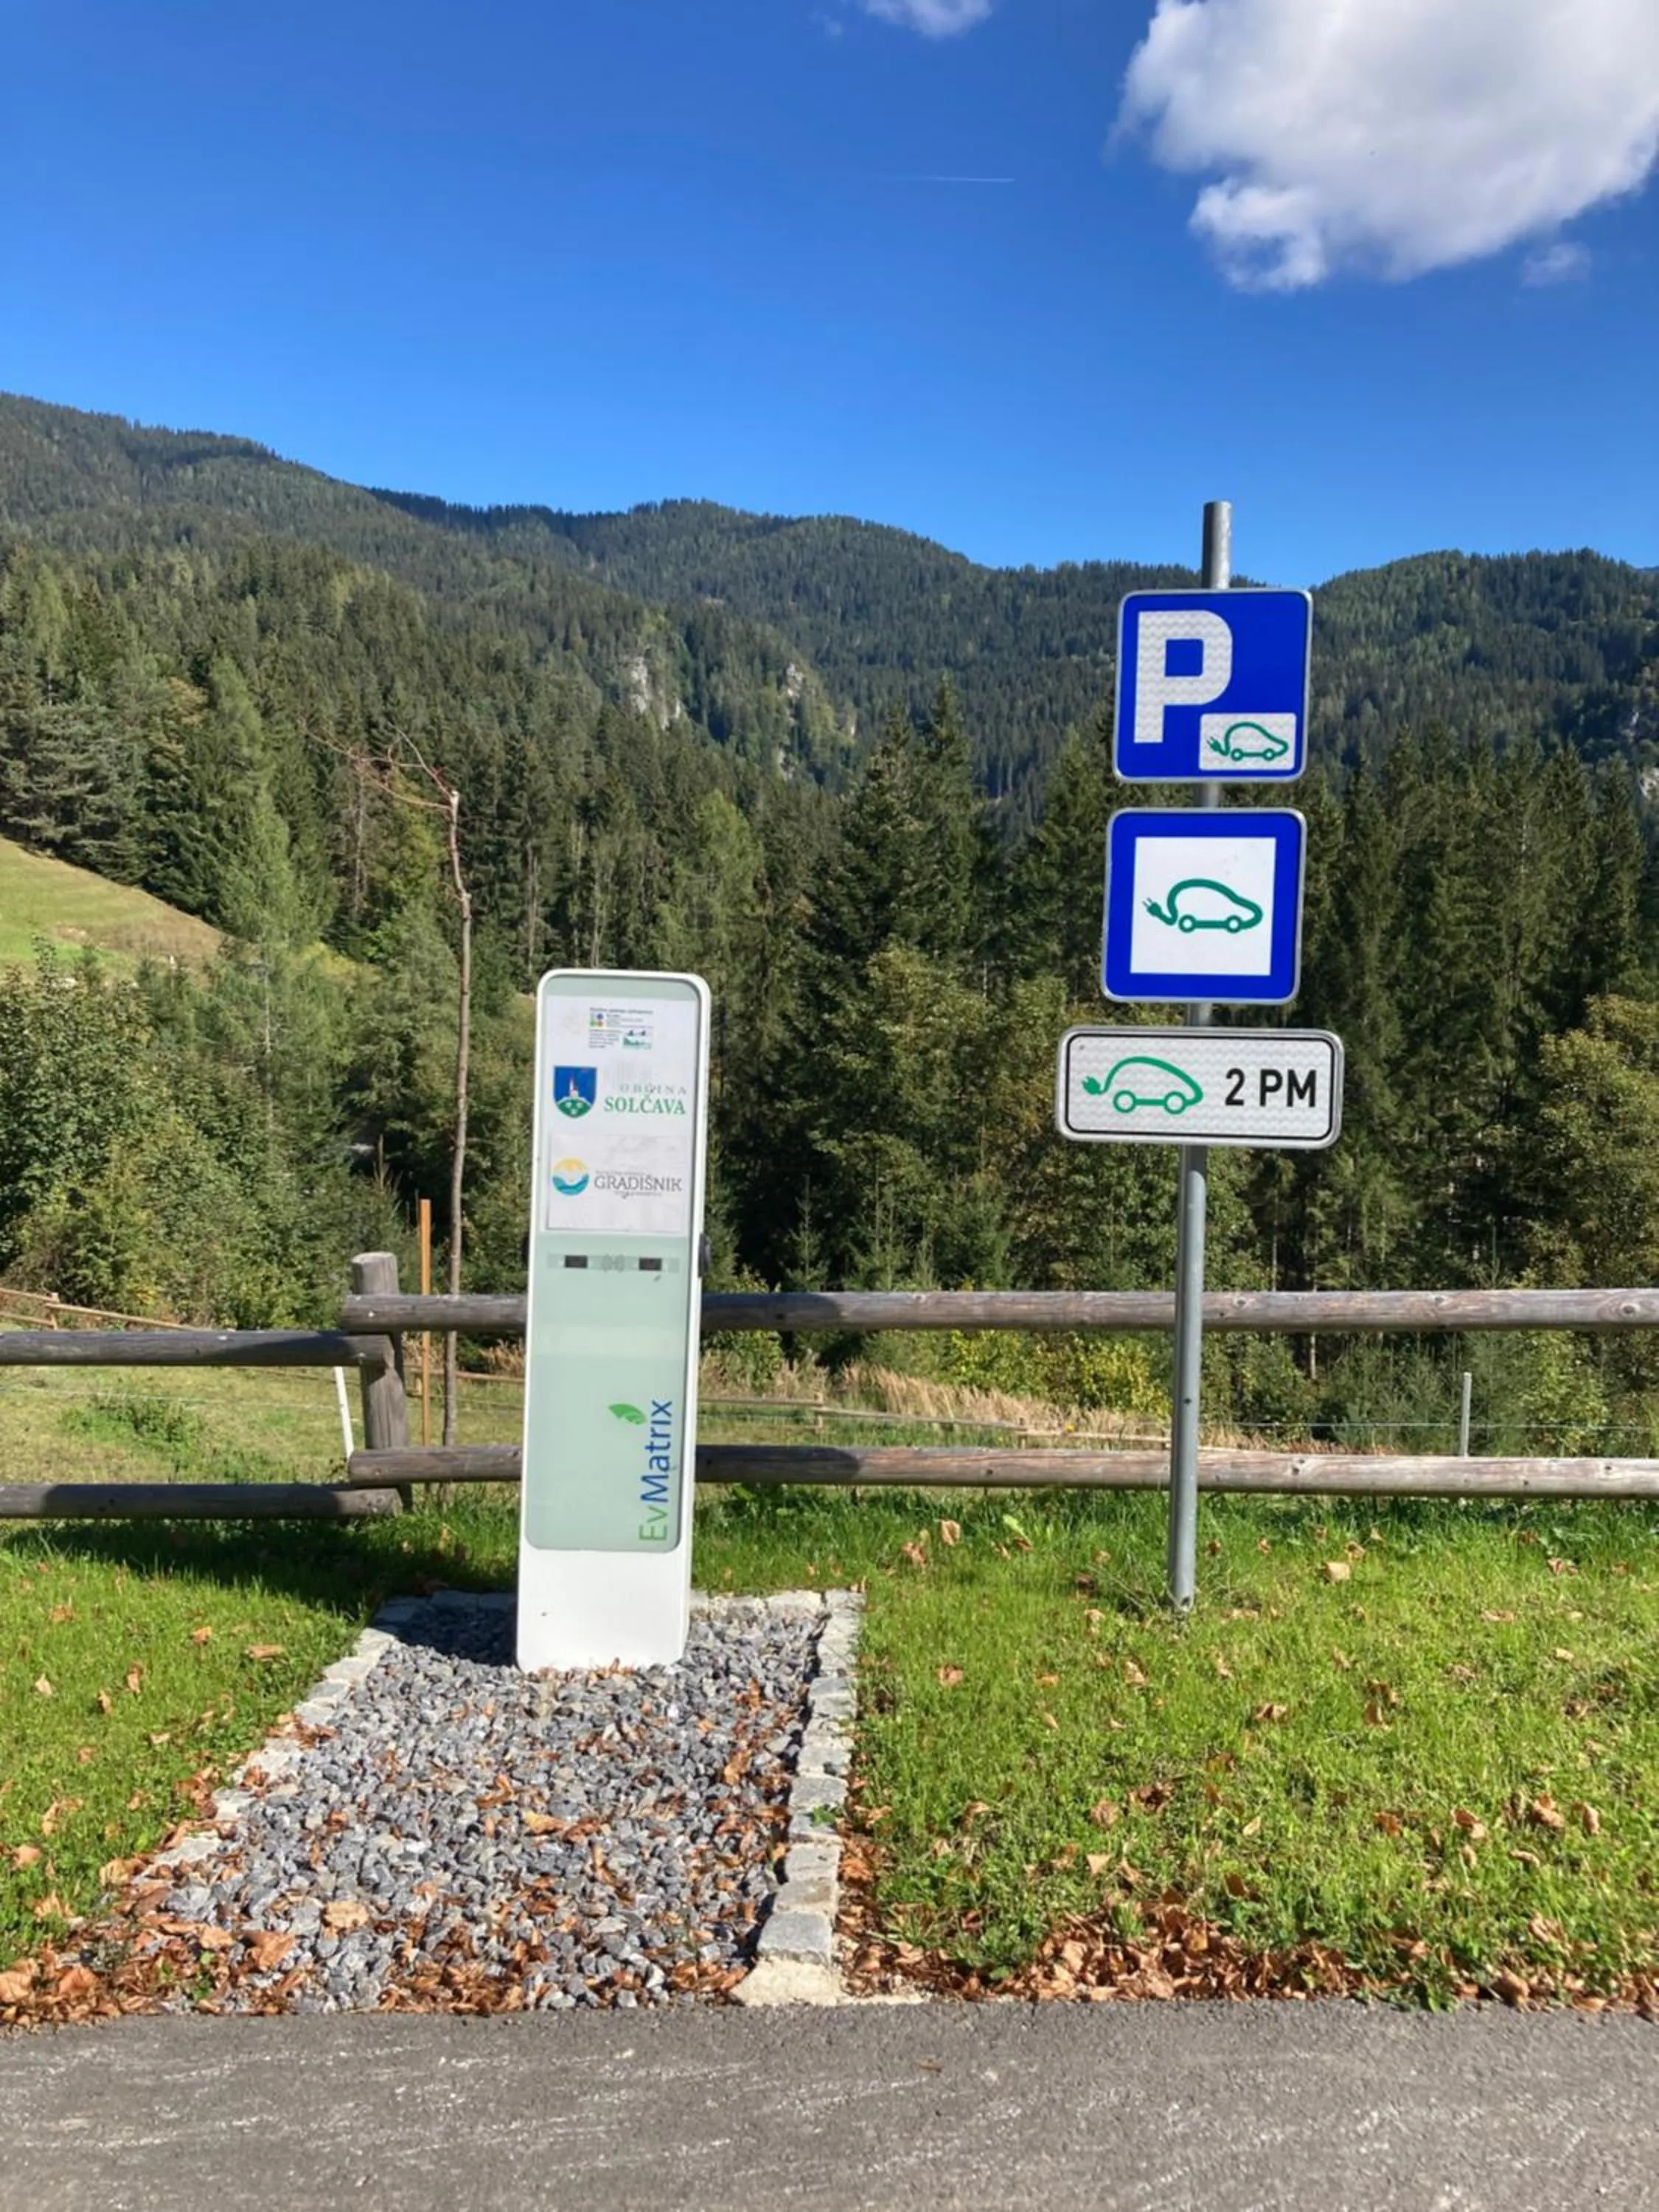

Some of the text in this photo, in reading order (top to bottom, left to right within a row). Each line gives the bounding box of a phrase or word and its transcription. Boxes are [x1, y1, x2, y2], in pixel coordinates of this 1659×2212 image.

[1134, 610, 1233, 743] P
[604, 1094, 686, 1115] SOLČAVA
[1225, 1068, 1317, 1108] 2 PM
[594, 1174, 683, 1192] GRADIŠNIK
[639, 1399, 672, 1541] EvMatrix
